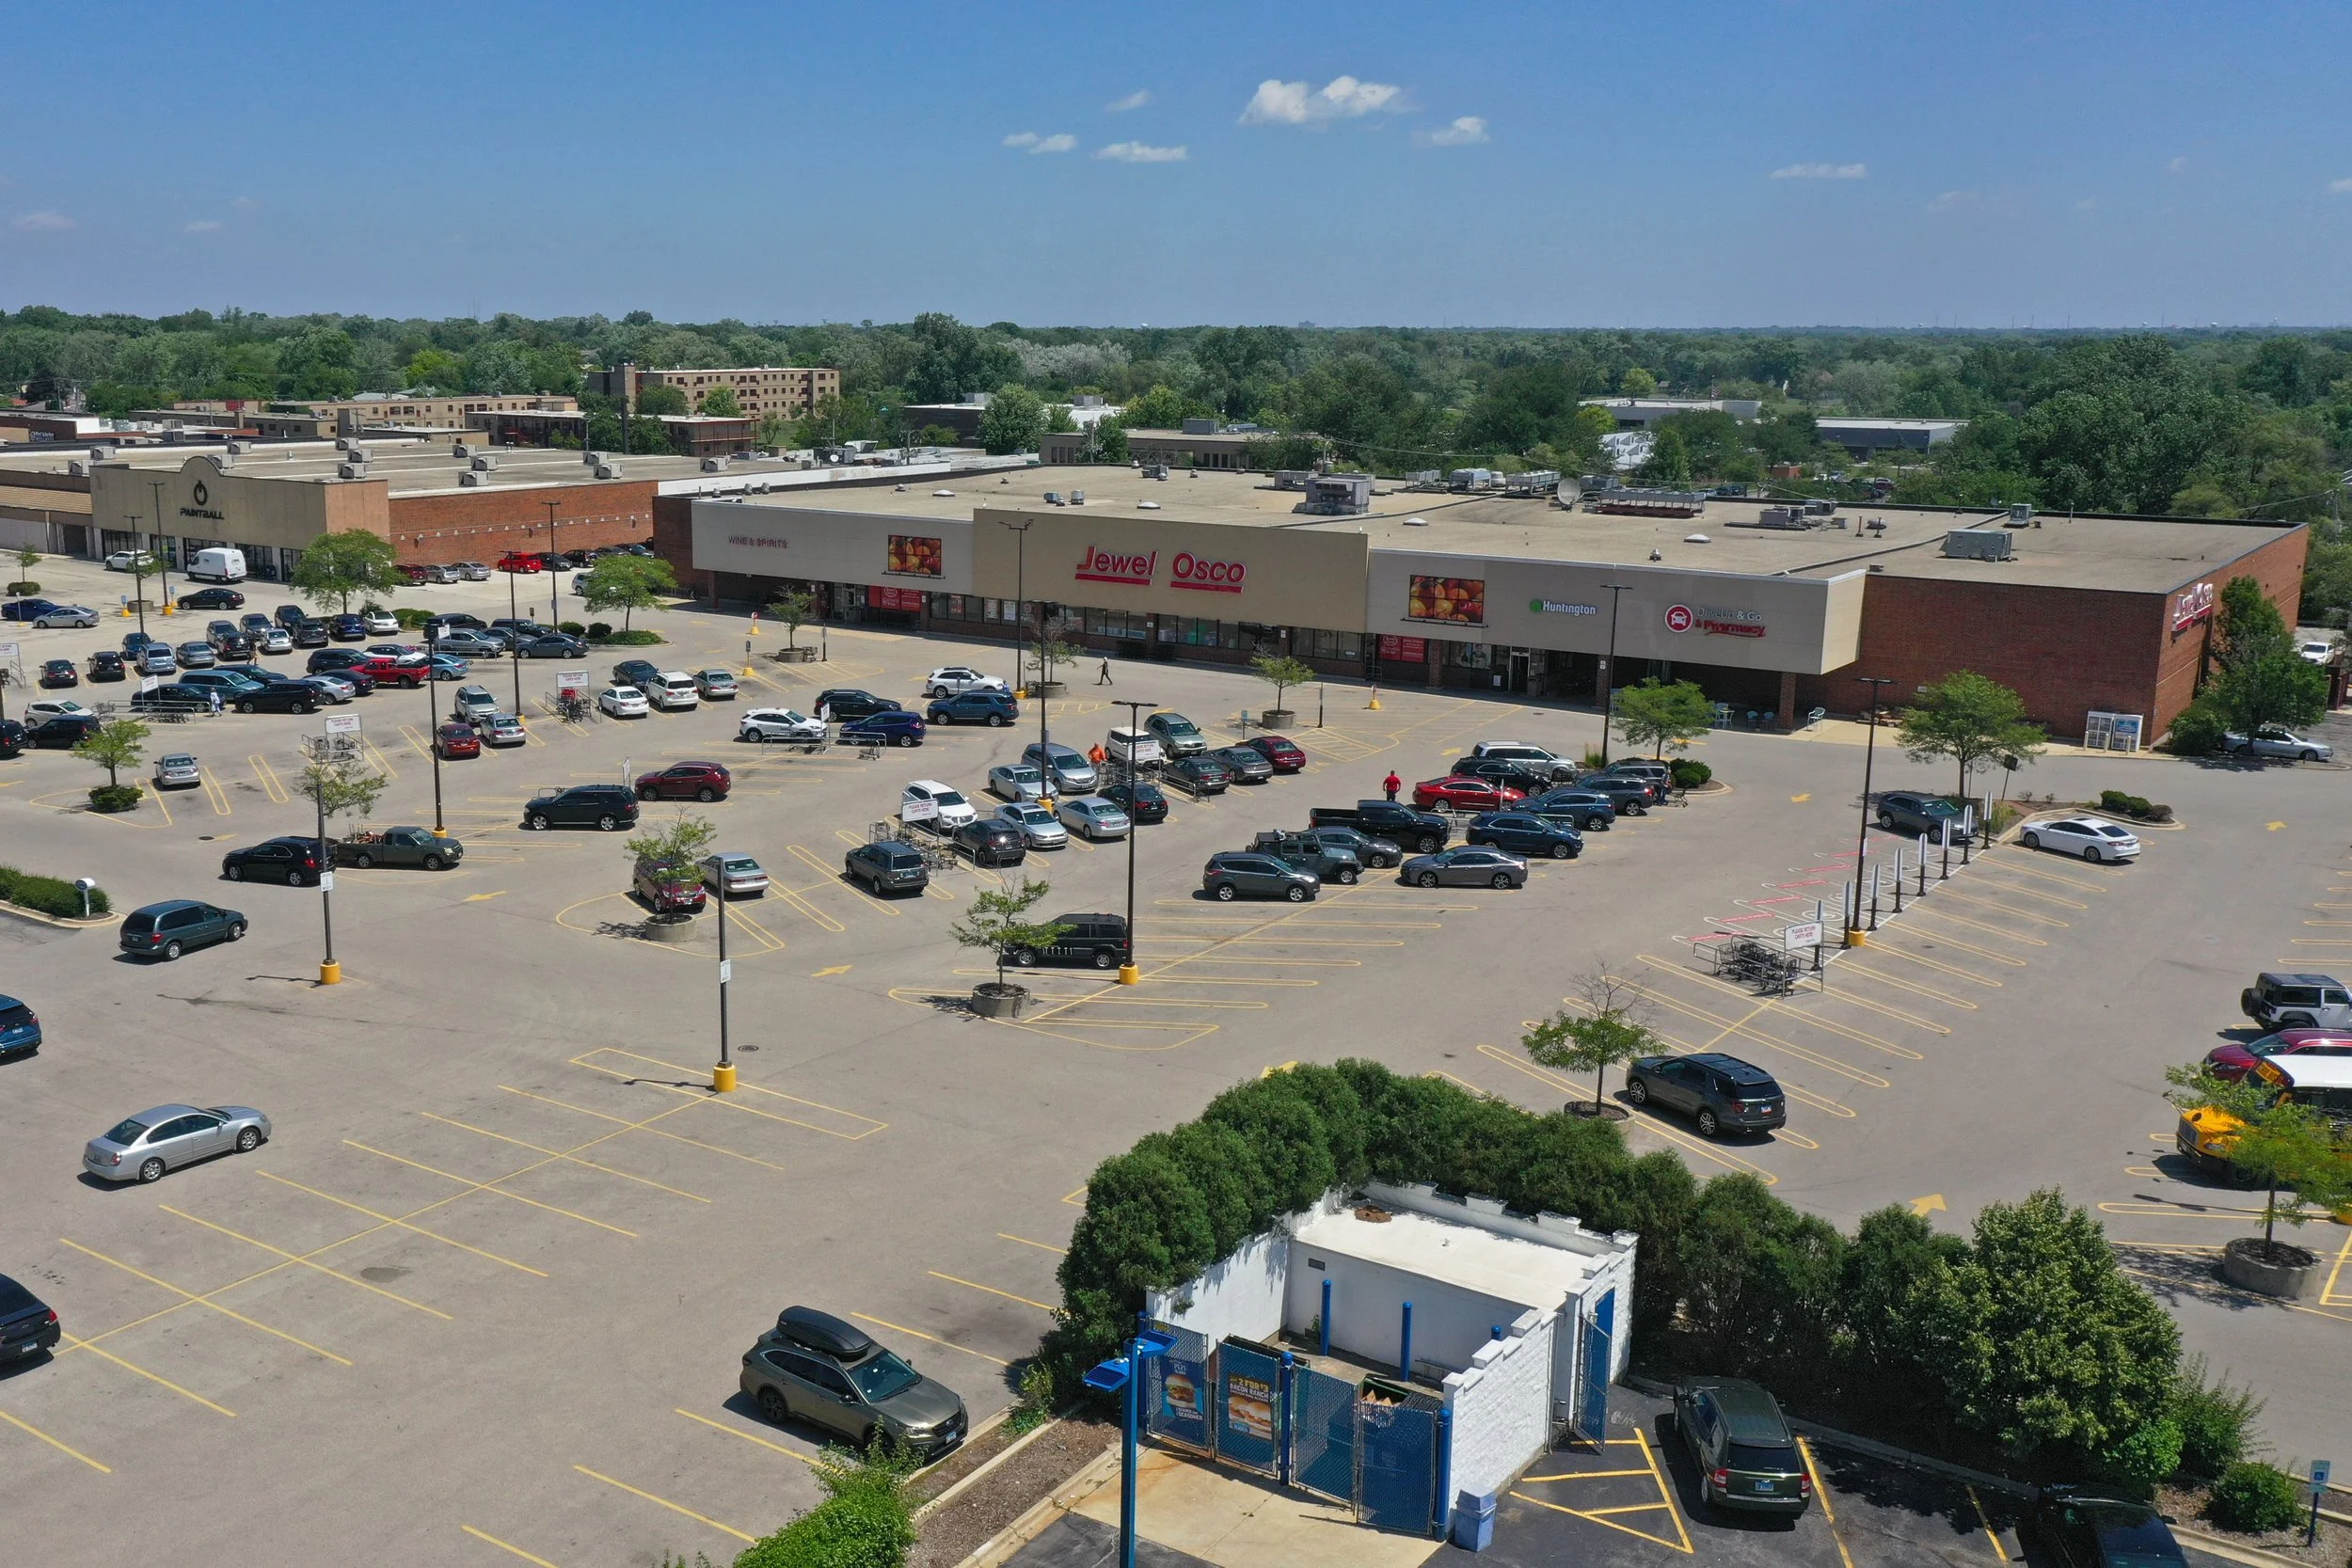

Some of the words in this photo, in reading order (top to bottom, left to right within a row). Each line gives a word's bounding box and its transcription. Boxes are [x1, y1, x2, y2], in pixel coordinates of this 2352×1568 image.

[180, 508, 225, 519] PAINTBALL
[728, 535, 747, 546] WINE
[749, 537, 754, 546] &
[756, 538, 787, 548] SPIRITS
[1076, 546, 1158, 577] Jewel
[1172, 552, 1247, 583] Osco
[1543, 600, 1597, 617] Huntington
[1696, 607, 1734, 619] DriveUp
[1737, 610, 1745, 620] &
[1747, 611, 1762, 622] Go
[1704, 620, 1766, 637] Pharmacy
[1230, 1383, 1248, 1392] BACON
[1249, 1387, 1269, 1399] RANCH
[1238, 1378, 1244, 1386] 2
[1245, 1379, 1260, 1389] FOR
[1261, 1383, 1269, 1393] $3
[1178, 1412, 1203, 1420] SEASONED
